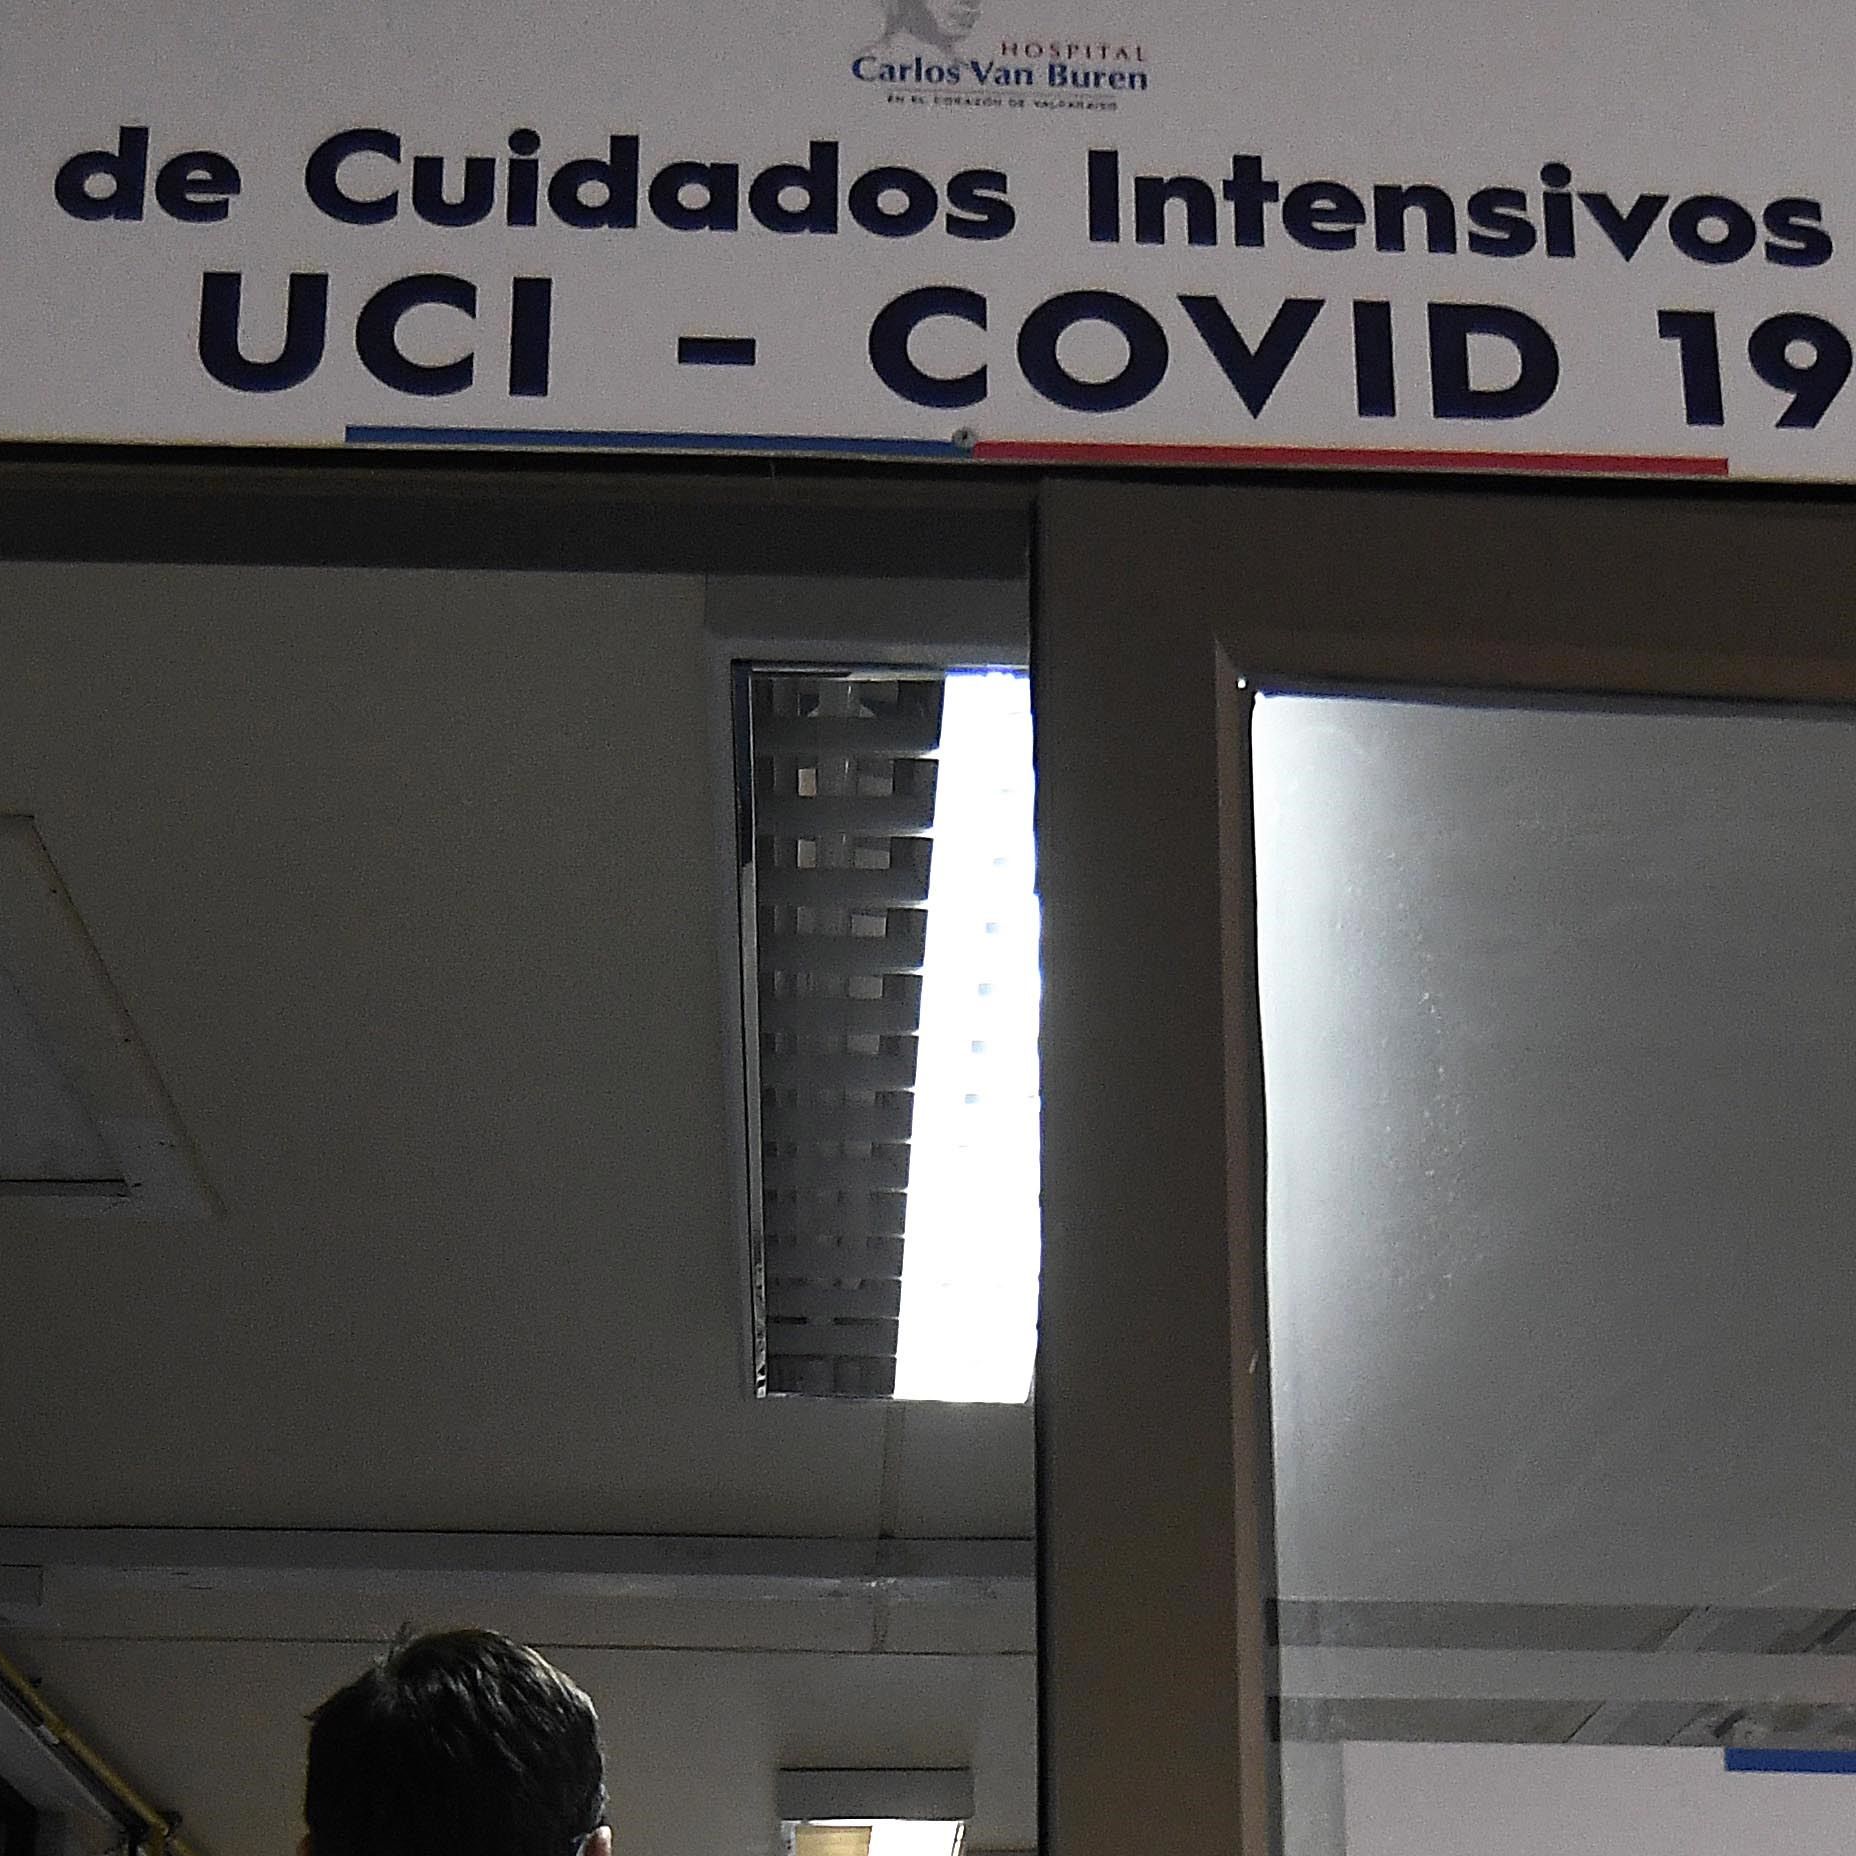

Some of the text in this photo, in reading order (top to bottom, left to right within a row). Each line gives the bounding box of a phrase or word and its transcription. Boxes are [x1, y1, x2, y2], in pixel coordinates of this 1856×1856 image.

[851, 55, 1149, 92] Carlos Van Buren
[1000, 41, 1146, 63] HOSPITAL
[54, 125, 242, 223] de
[304, 127, 1016, 241] Cuidados
[1087, 149, 1833, 268] Intensivos
[198, 271, 1854, 431] UCI - COVID 19
